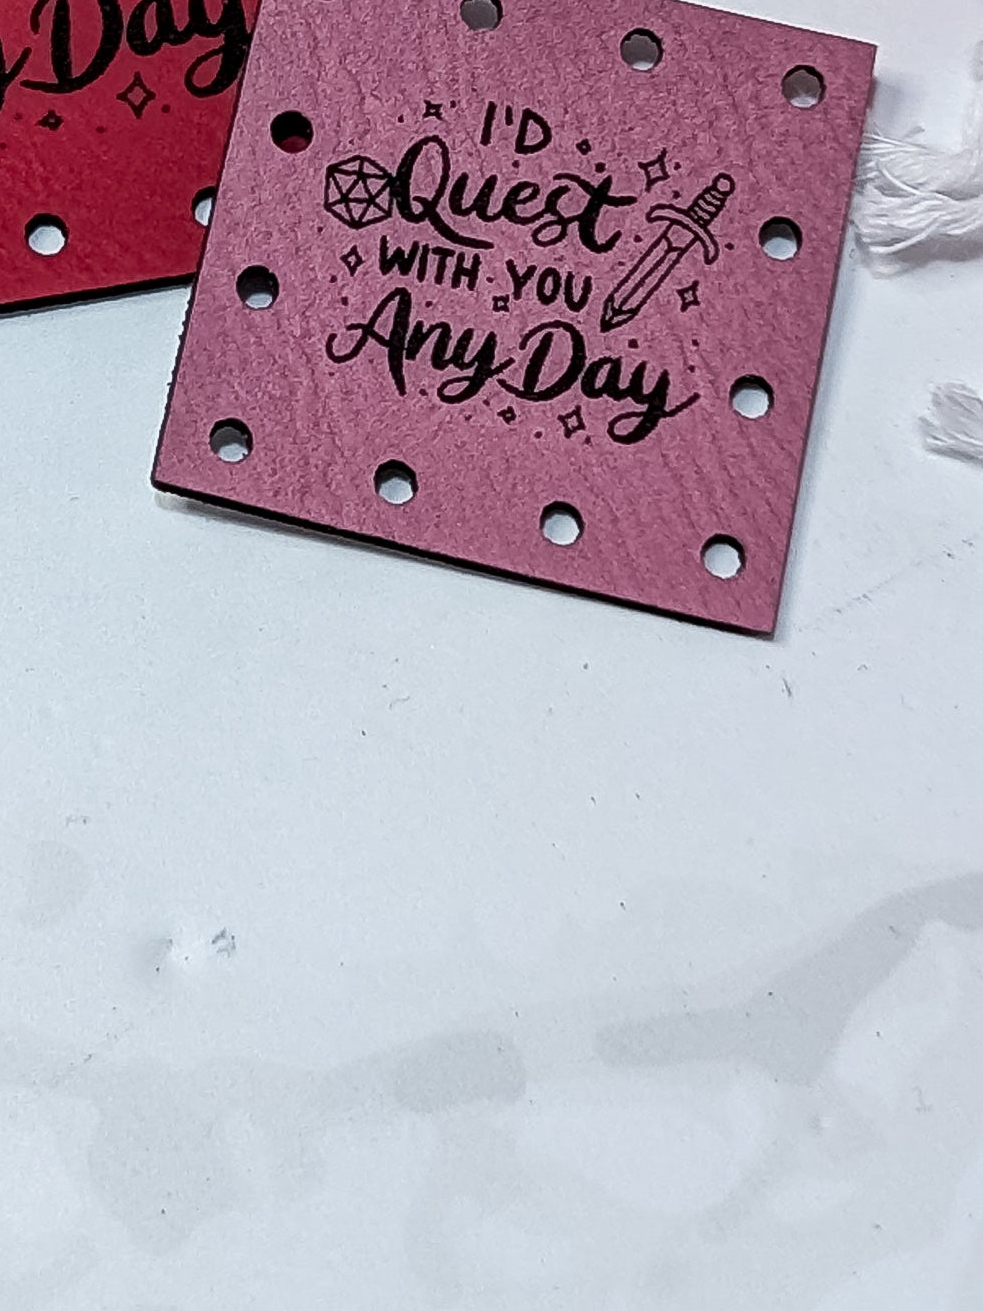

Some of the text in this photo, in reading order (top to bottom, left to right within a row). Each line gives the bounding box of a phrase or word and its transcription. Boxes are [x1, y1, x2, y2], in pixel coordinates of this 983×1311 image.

[480, 101, 552, 154] I'D
[392, 135, 637, 253] Quest
[379, 235, 592, 312] WITH YOU
[326, 287, 701, 444] Any Day
